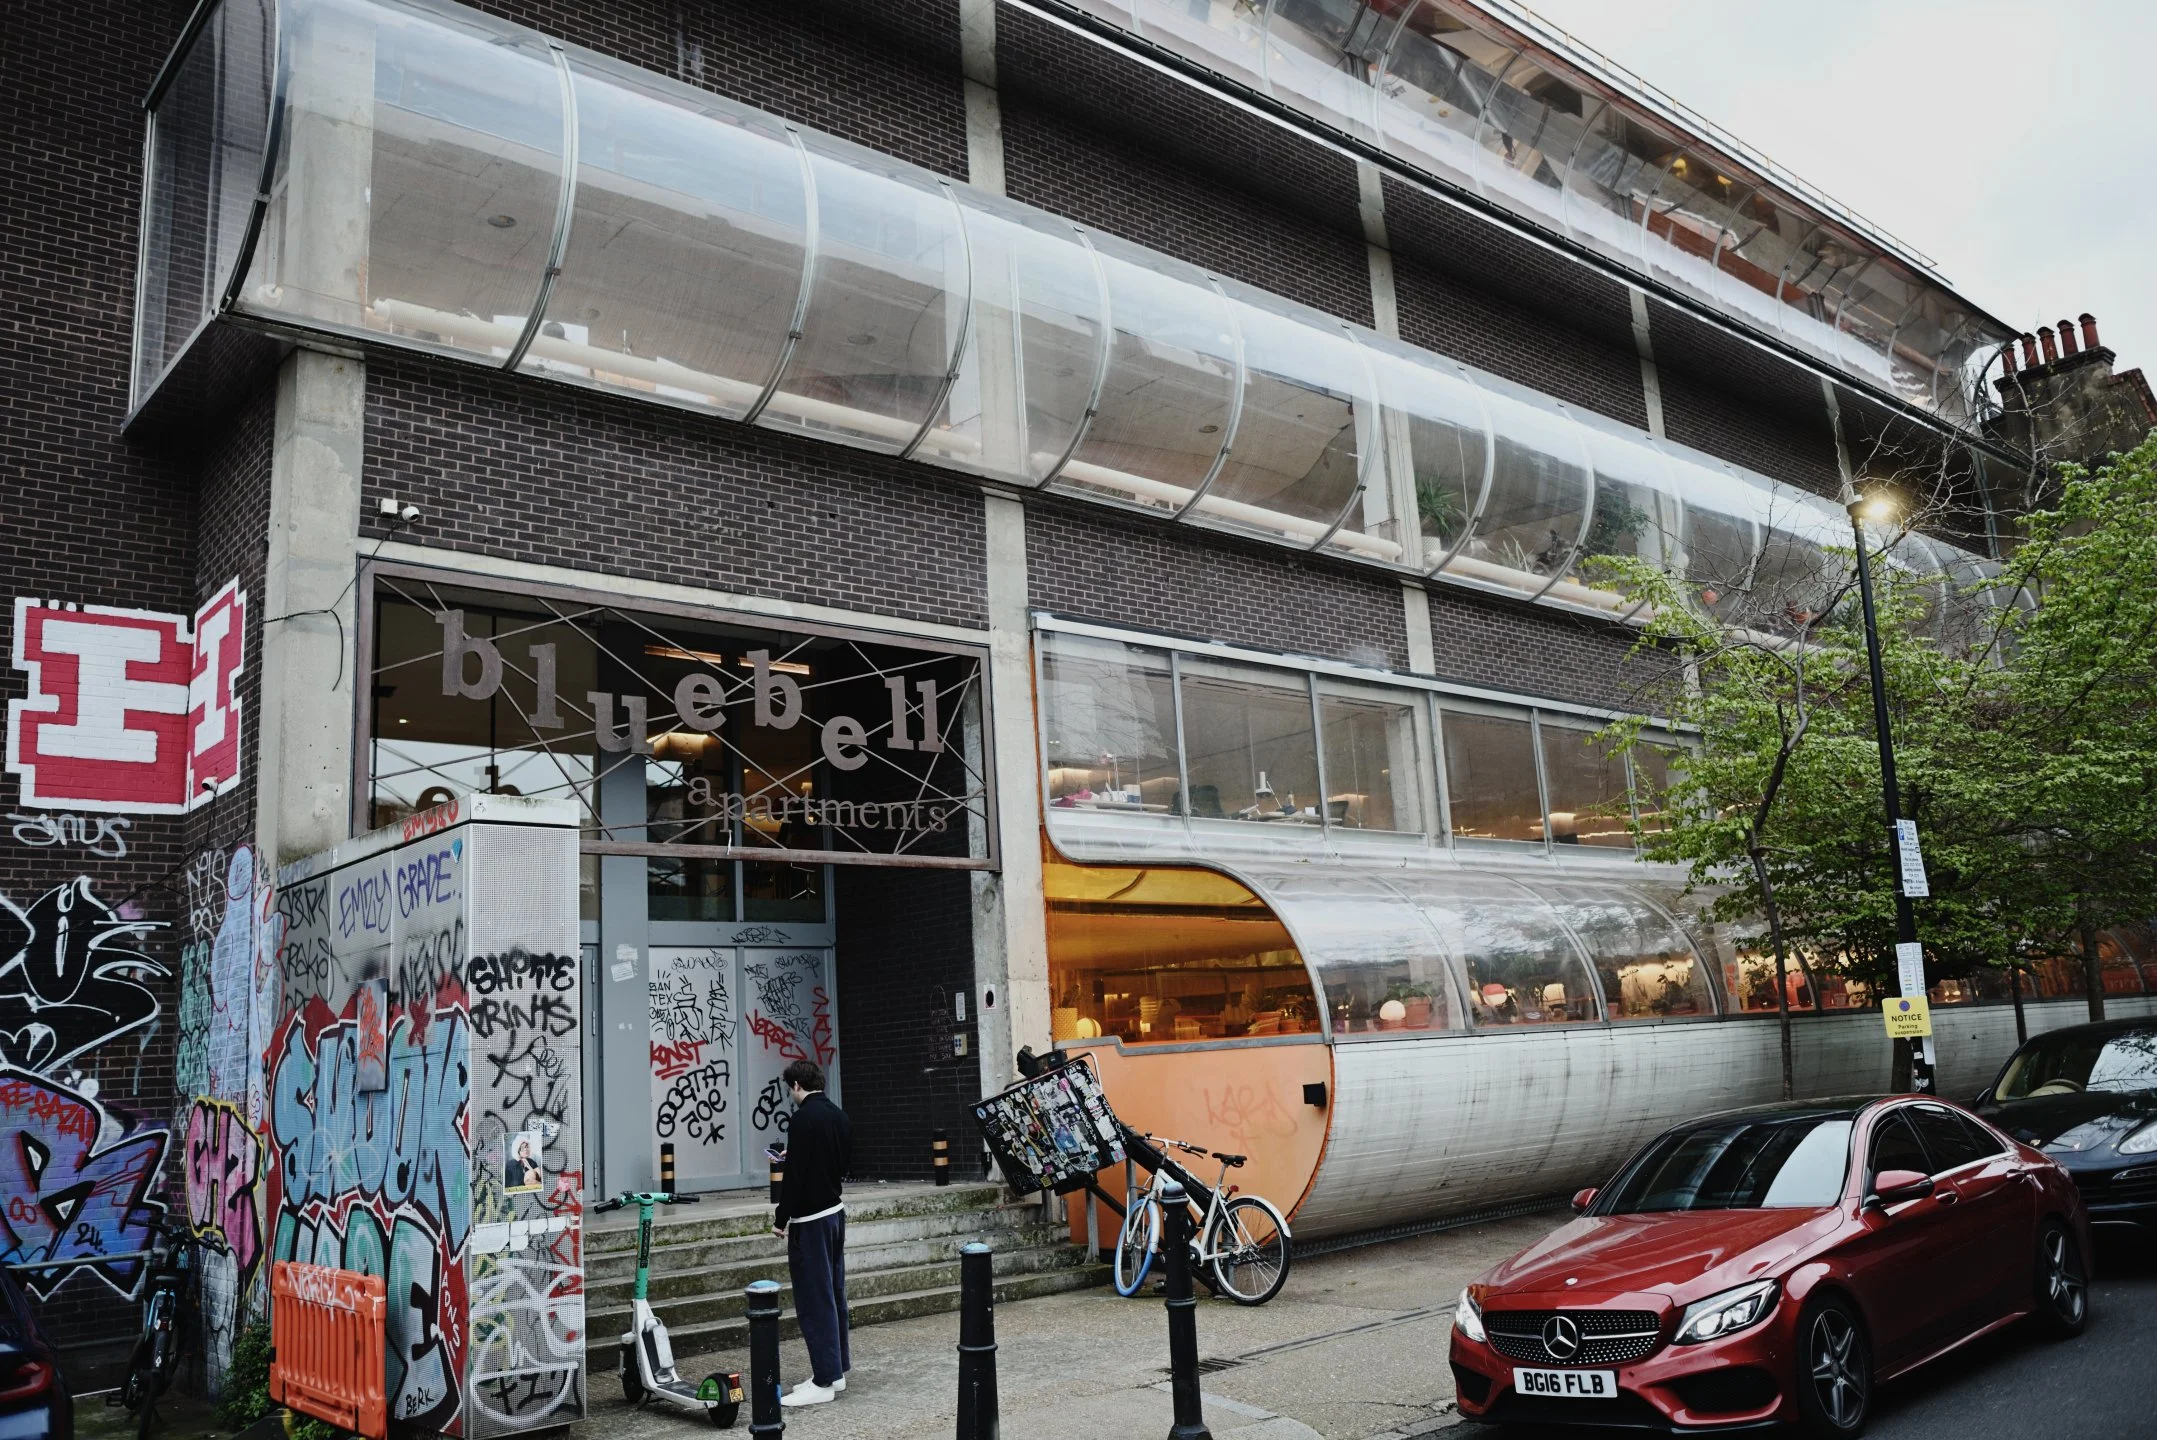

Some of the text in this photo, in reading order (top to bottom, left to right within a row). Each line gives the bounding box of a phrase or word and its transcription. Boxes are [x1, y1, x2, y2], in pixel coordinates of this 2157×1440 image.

[435, 609, 946, 771] bluebell
[687, 775, 948, 834] apartments
[1891, 1013, 1923, 1022] NOTICE
[1522, 1371, 1604, 1395] BG16 FLB
